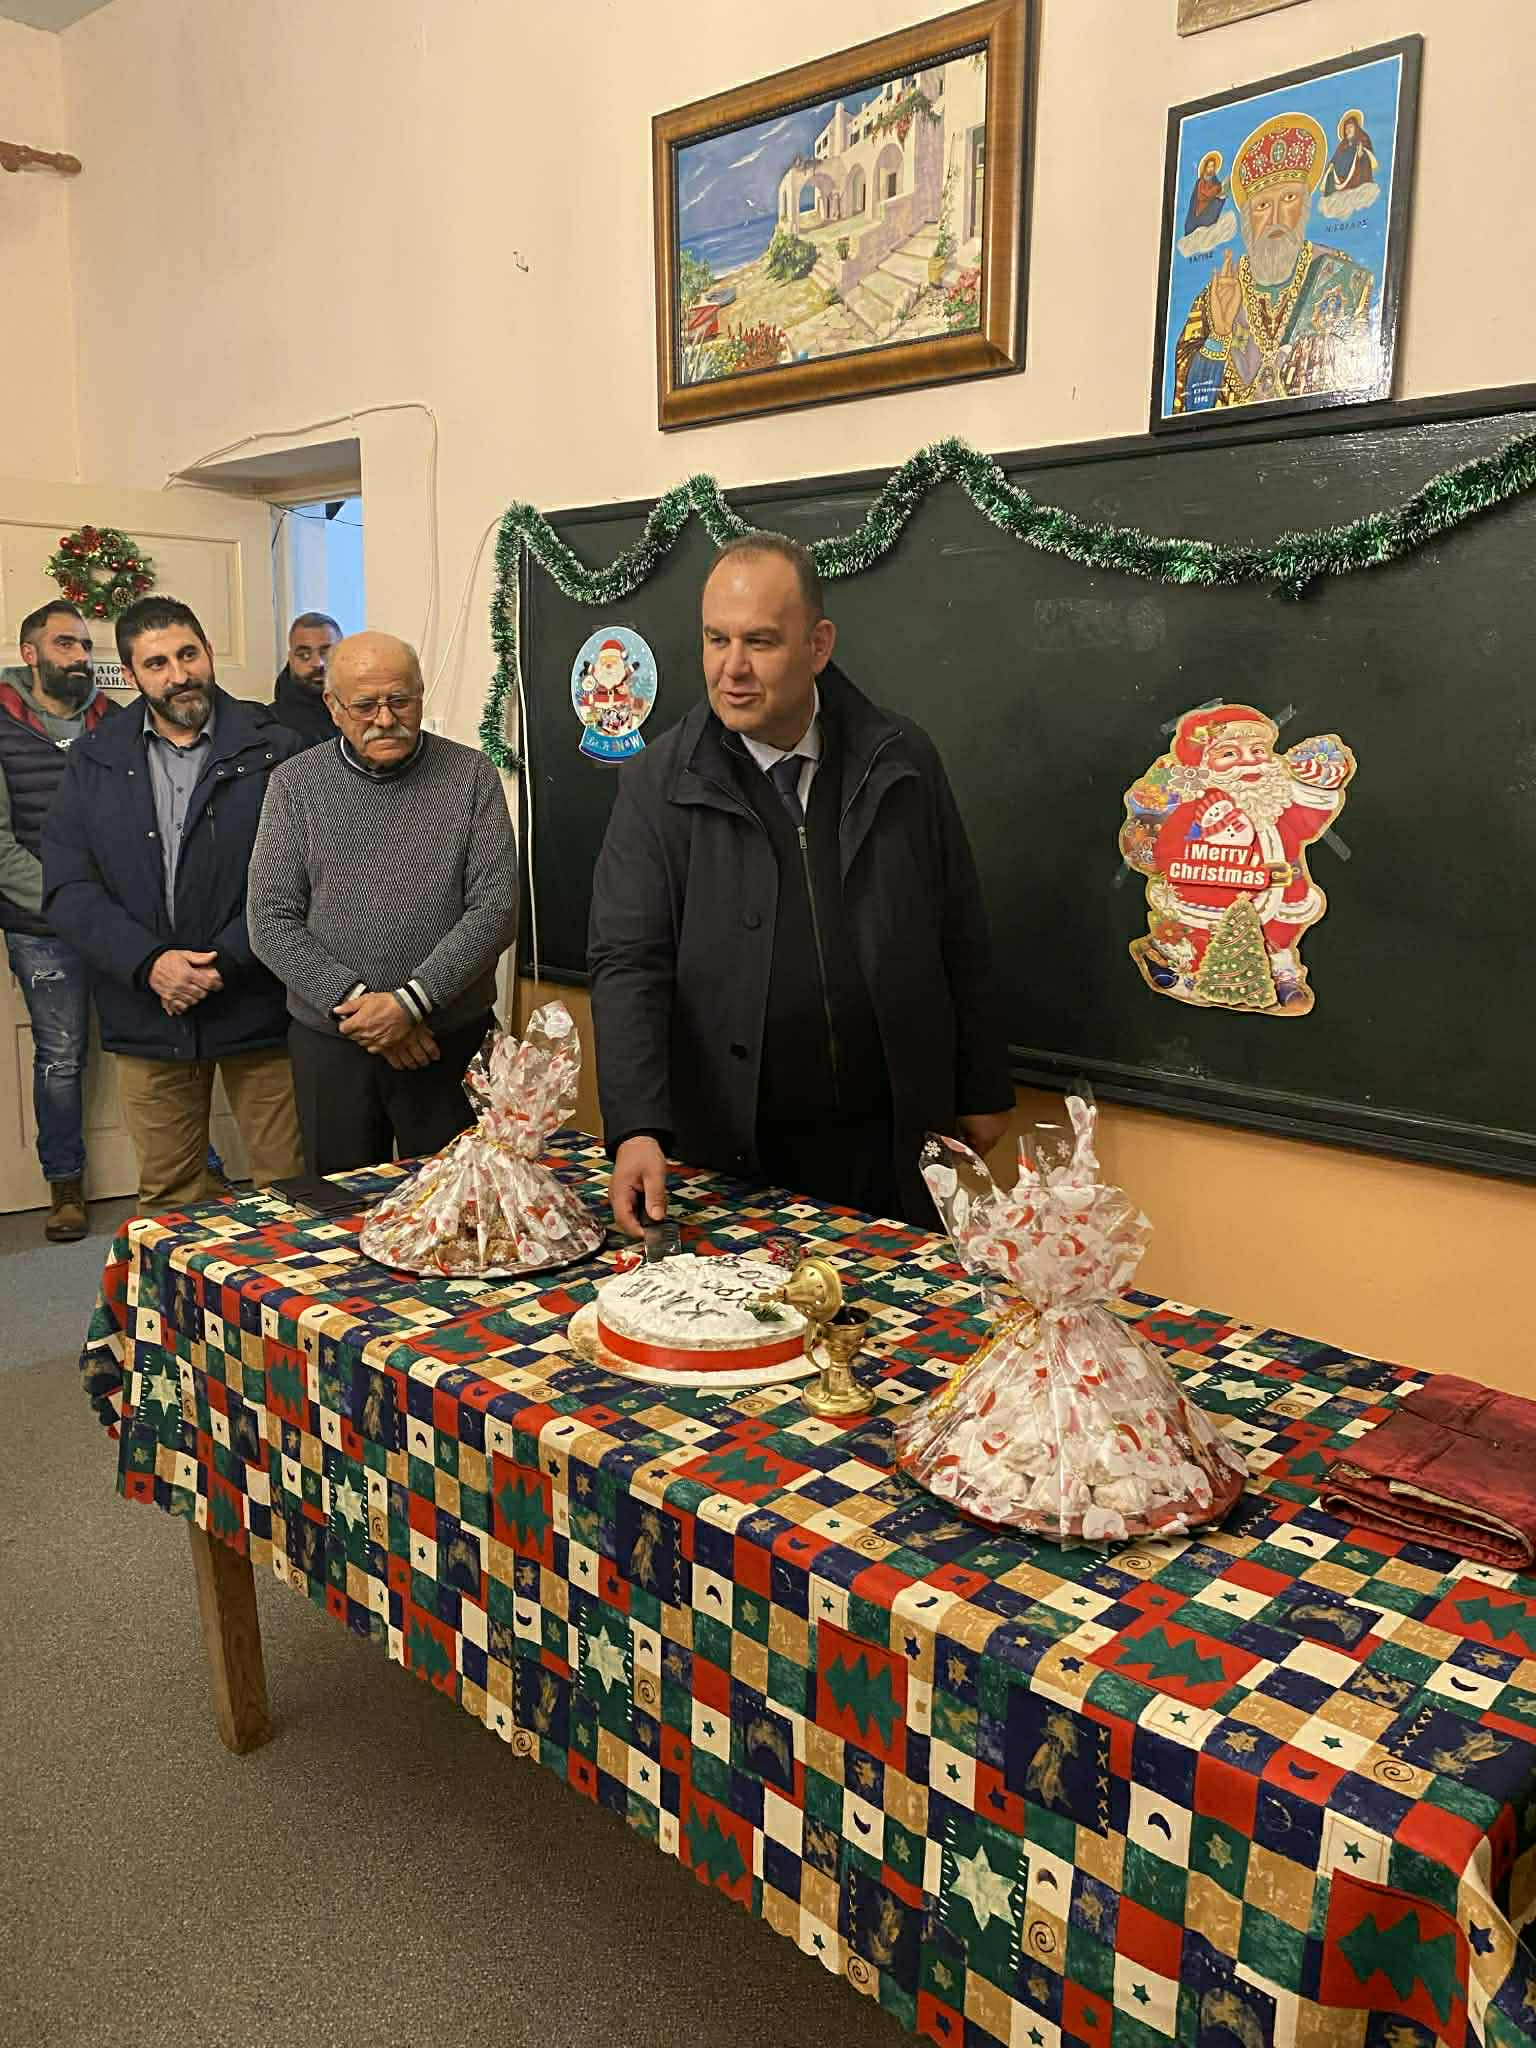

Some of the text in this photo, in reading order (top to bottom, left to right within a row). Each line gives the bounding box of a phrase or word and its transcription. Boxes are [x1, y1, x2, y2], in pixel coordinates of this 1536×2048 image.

[97, 665, 121, 674] ΑΙΘ
[1191, 843, 1248, 865] Merry
[1169, 862, 1265, 885] Christmas
